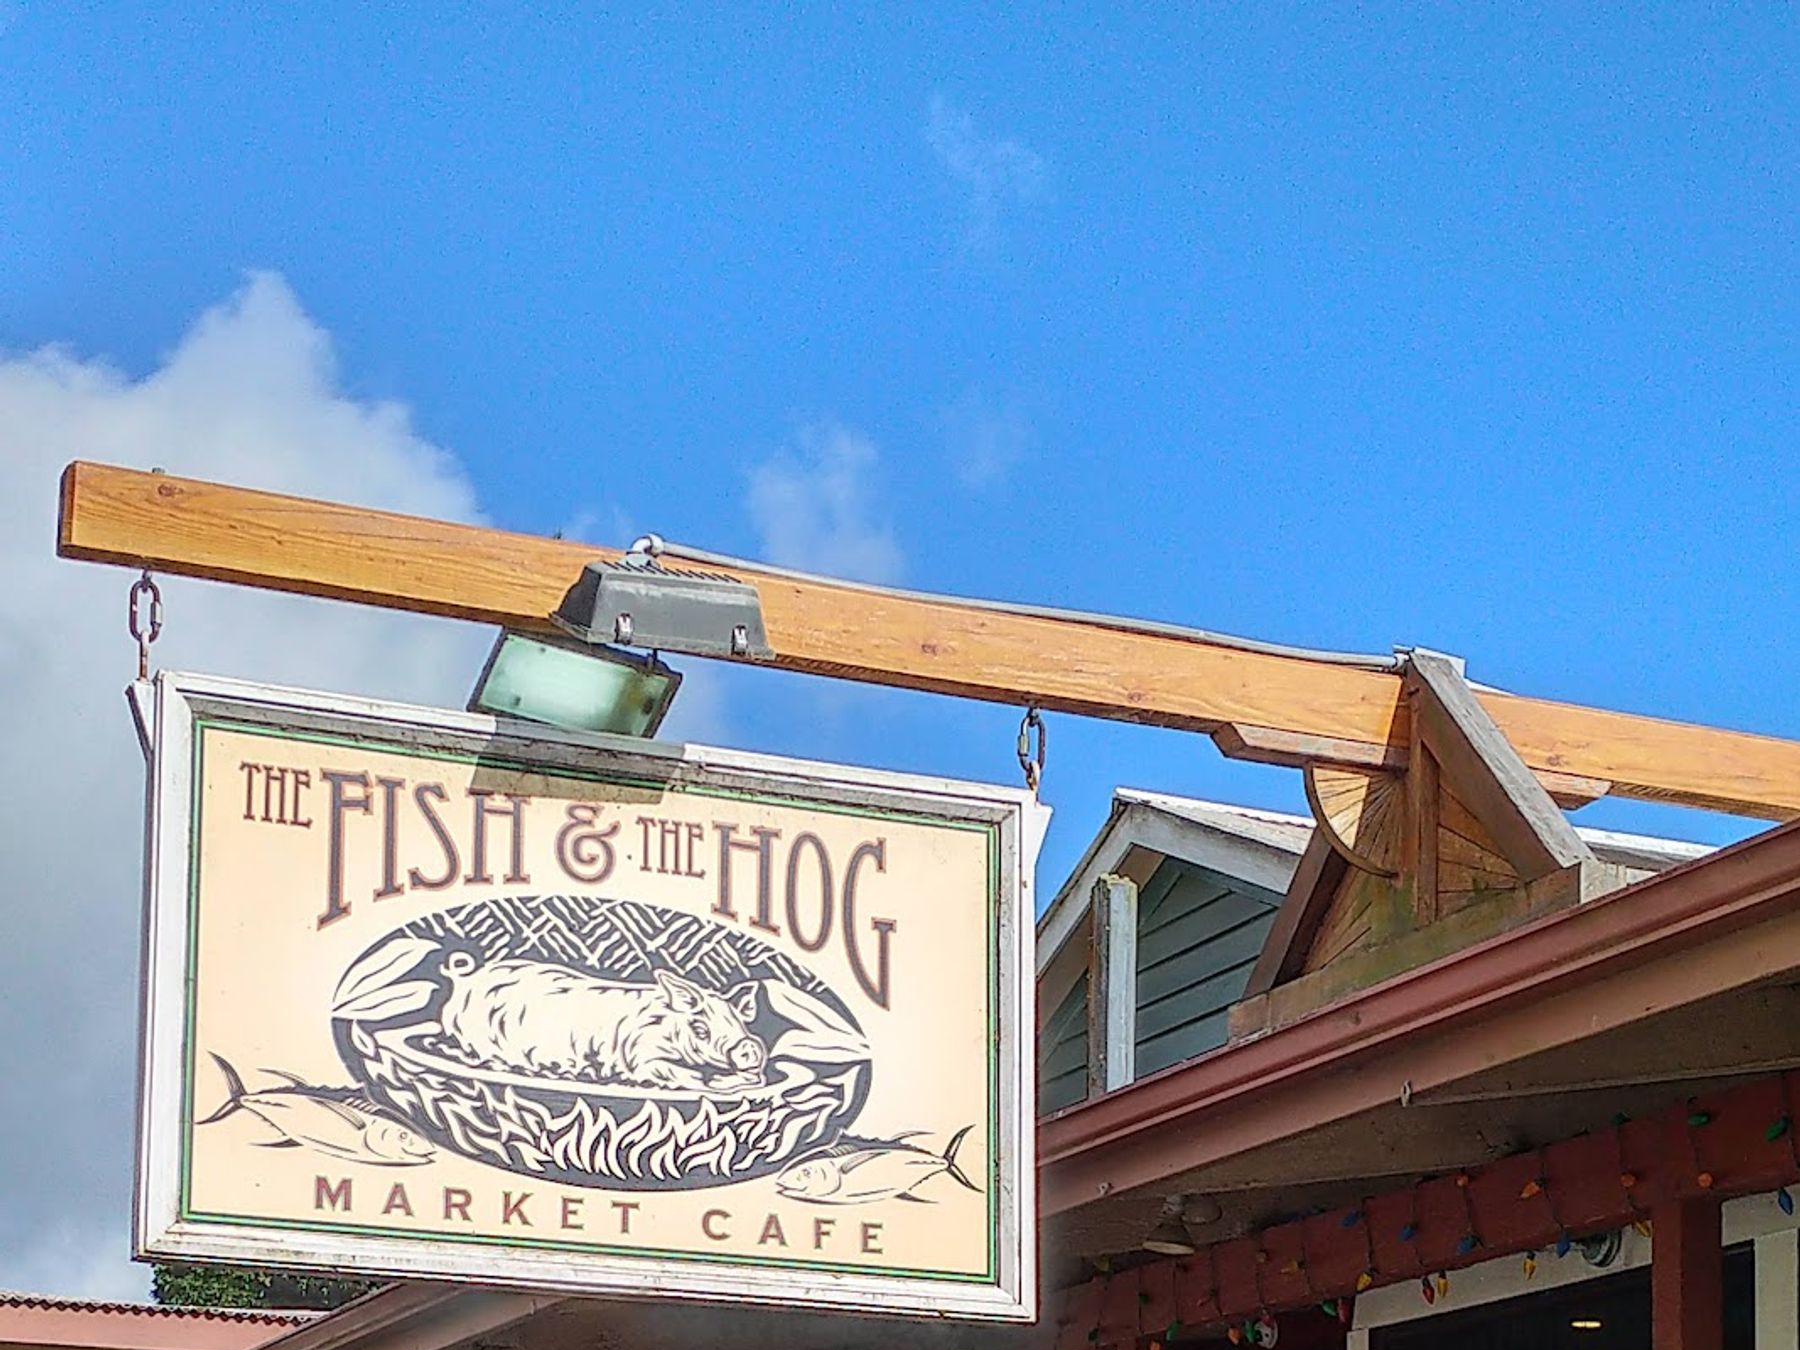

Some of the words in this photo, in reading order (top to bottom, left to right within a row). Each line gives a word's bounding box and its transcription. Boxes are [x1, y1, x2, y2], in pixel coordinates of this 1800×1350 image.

[239, 761, 313, 829] THE
[315, 768, 532, 930] FISH
[554, 801, 622, 883] &
[637, 816, 706, 879] THE
[711, 820, 897, 1011] HOG
[313, 1174, 640, 1235] MARKET
[701, 1208, 885, 1255] CAFE
